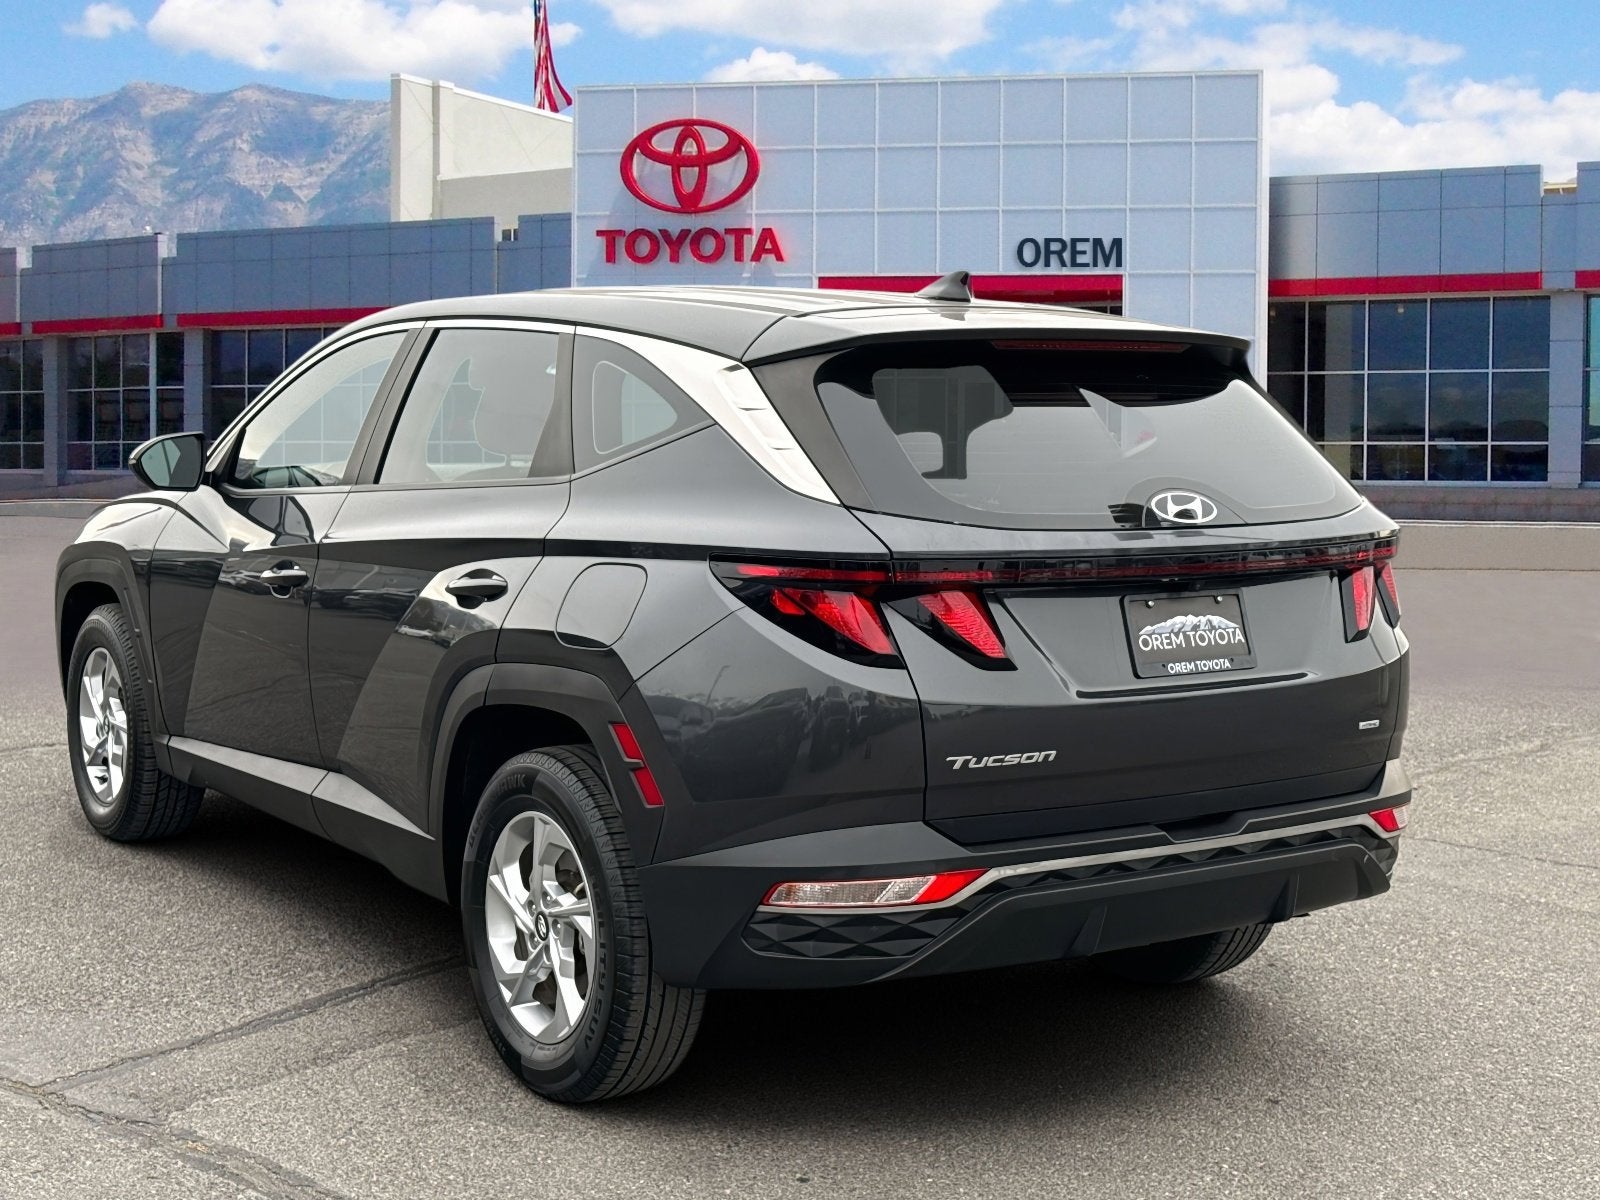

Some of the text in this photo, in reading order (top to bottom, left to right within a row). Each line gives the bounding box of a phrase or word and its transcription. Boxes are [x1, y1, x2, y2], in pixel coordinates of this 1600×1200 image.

[596, 228, 785, 264] TOYOTA
[1017, 238, 1122, 267] OREM
[1139, 628, 1245, 651] OREM TOYOTA
[1168, 659, 1231, 673] OREM TOYOTA
